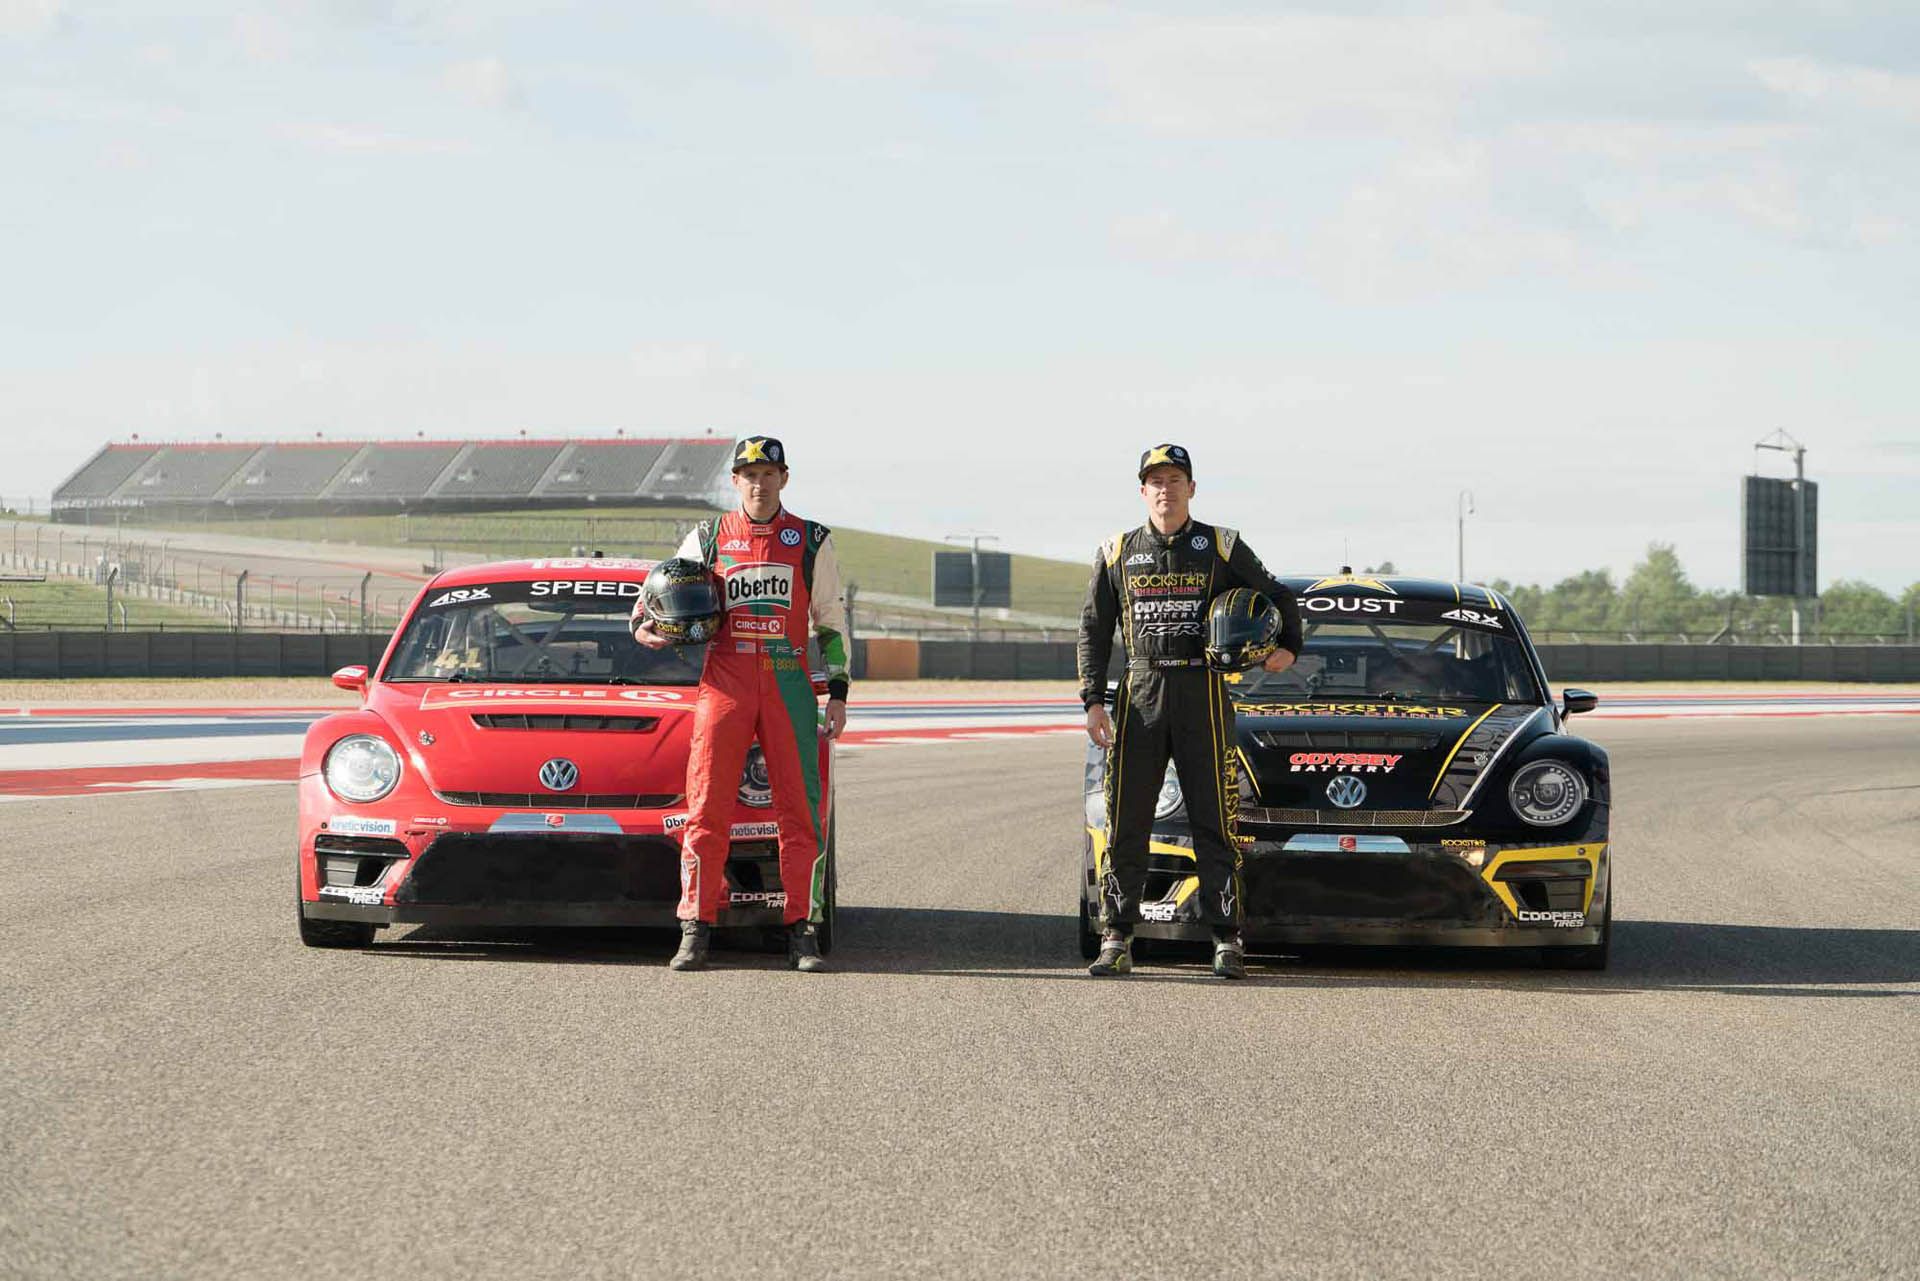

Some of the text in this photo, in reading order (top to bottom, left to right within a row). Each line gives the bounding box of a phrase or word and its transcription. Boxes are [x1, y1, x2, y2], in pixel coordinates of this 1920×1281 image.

[530, 581, 641, 596] SPEED
[729, 576, 789, 600] Oberto
[1134, 601, 1201, 612] ODYSSEY
[735, 621, 767, 630] CIRCLE
[448, 690, 607, 698] CIRCLE
[1290, 753, 1403, 765] ODYSSEY
[1290, 764, 1396, 773] BATTERY
[665, 818, 686, 828] Obe
[730, 892, 787, 902] COOPE
[767, 900, 785, 908] TIR
[1518, 911, 1584, 922] COOPER
[1552, 919, 1585, 929] TIRES
